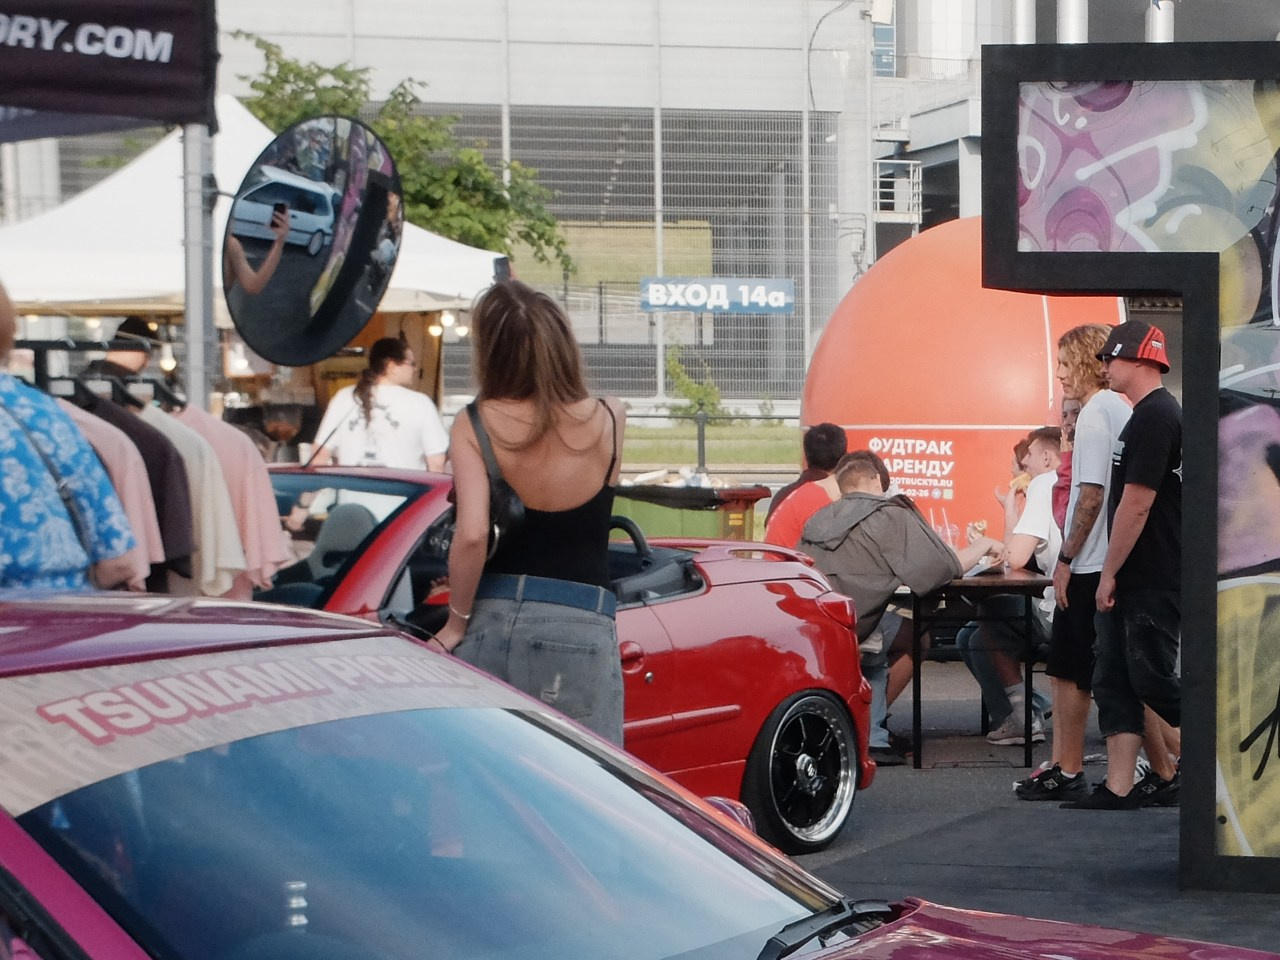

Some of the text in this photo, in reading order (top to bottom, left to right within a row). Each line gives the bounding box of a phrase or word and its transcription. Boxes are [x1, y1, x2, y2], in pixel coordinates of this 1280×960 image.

[648, 283, 729, 310] ВХОД
[868, 437, 953, 456] ФУДТРАК
[883, 458, 955, 477] АРЕНДУ
[37, 652, 479, 747] TSUNAMI PICNIC
